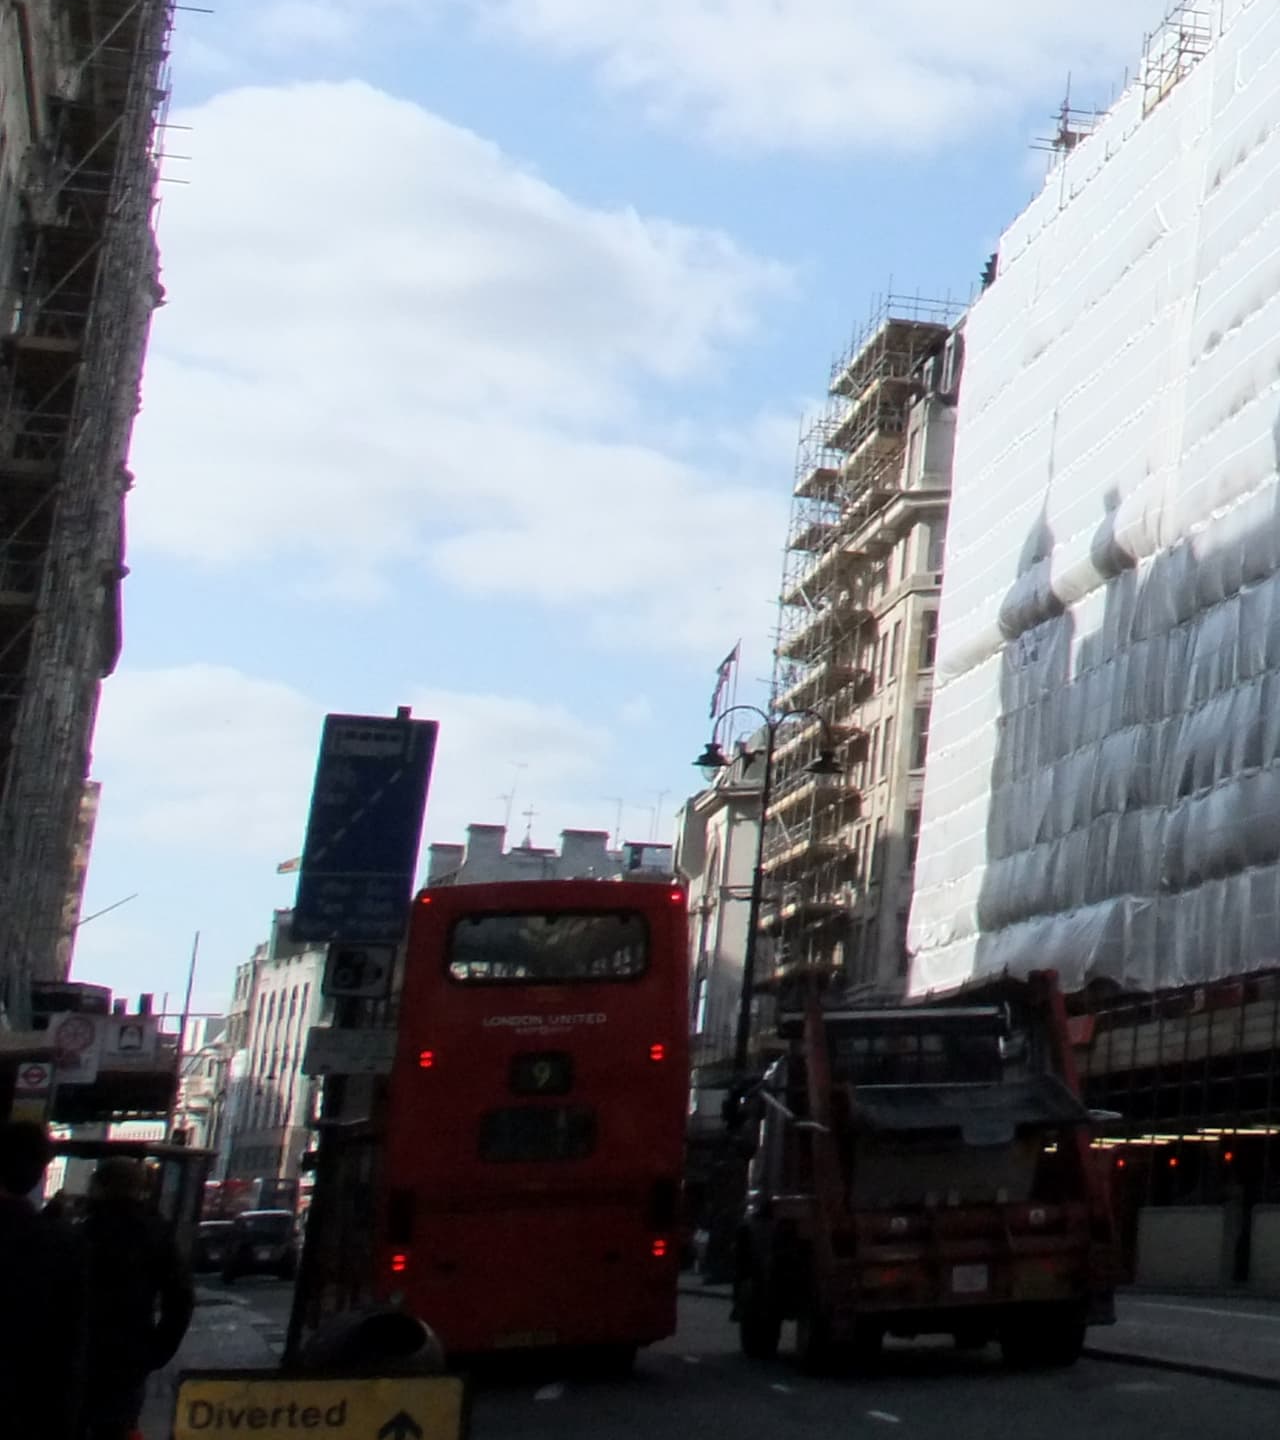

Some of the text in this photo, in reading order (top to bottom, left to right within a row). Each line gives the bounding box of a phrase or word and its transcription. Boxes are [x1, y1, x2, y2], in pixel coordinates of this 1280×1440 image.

[482, 1012, 608, 1026] LONDON UNITED
[532, 1060, 551, 1087] 9
[189, 1399, 347, 1429] Diverted
